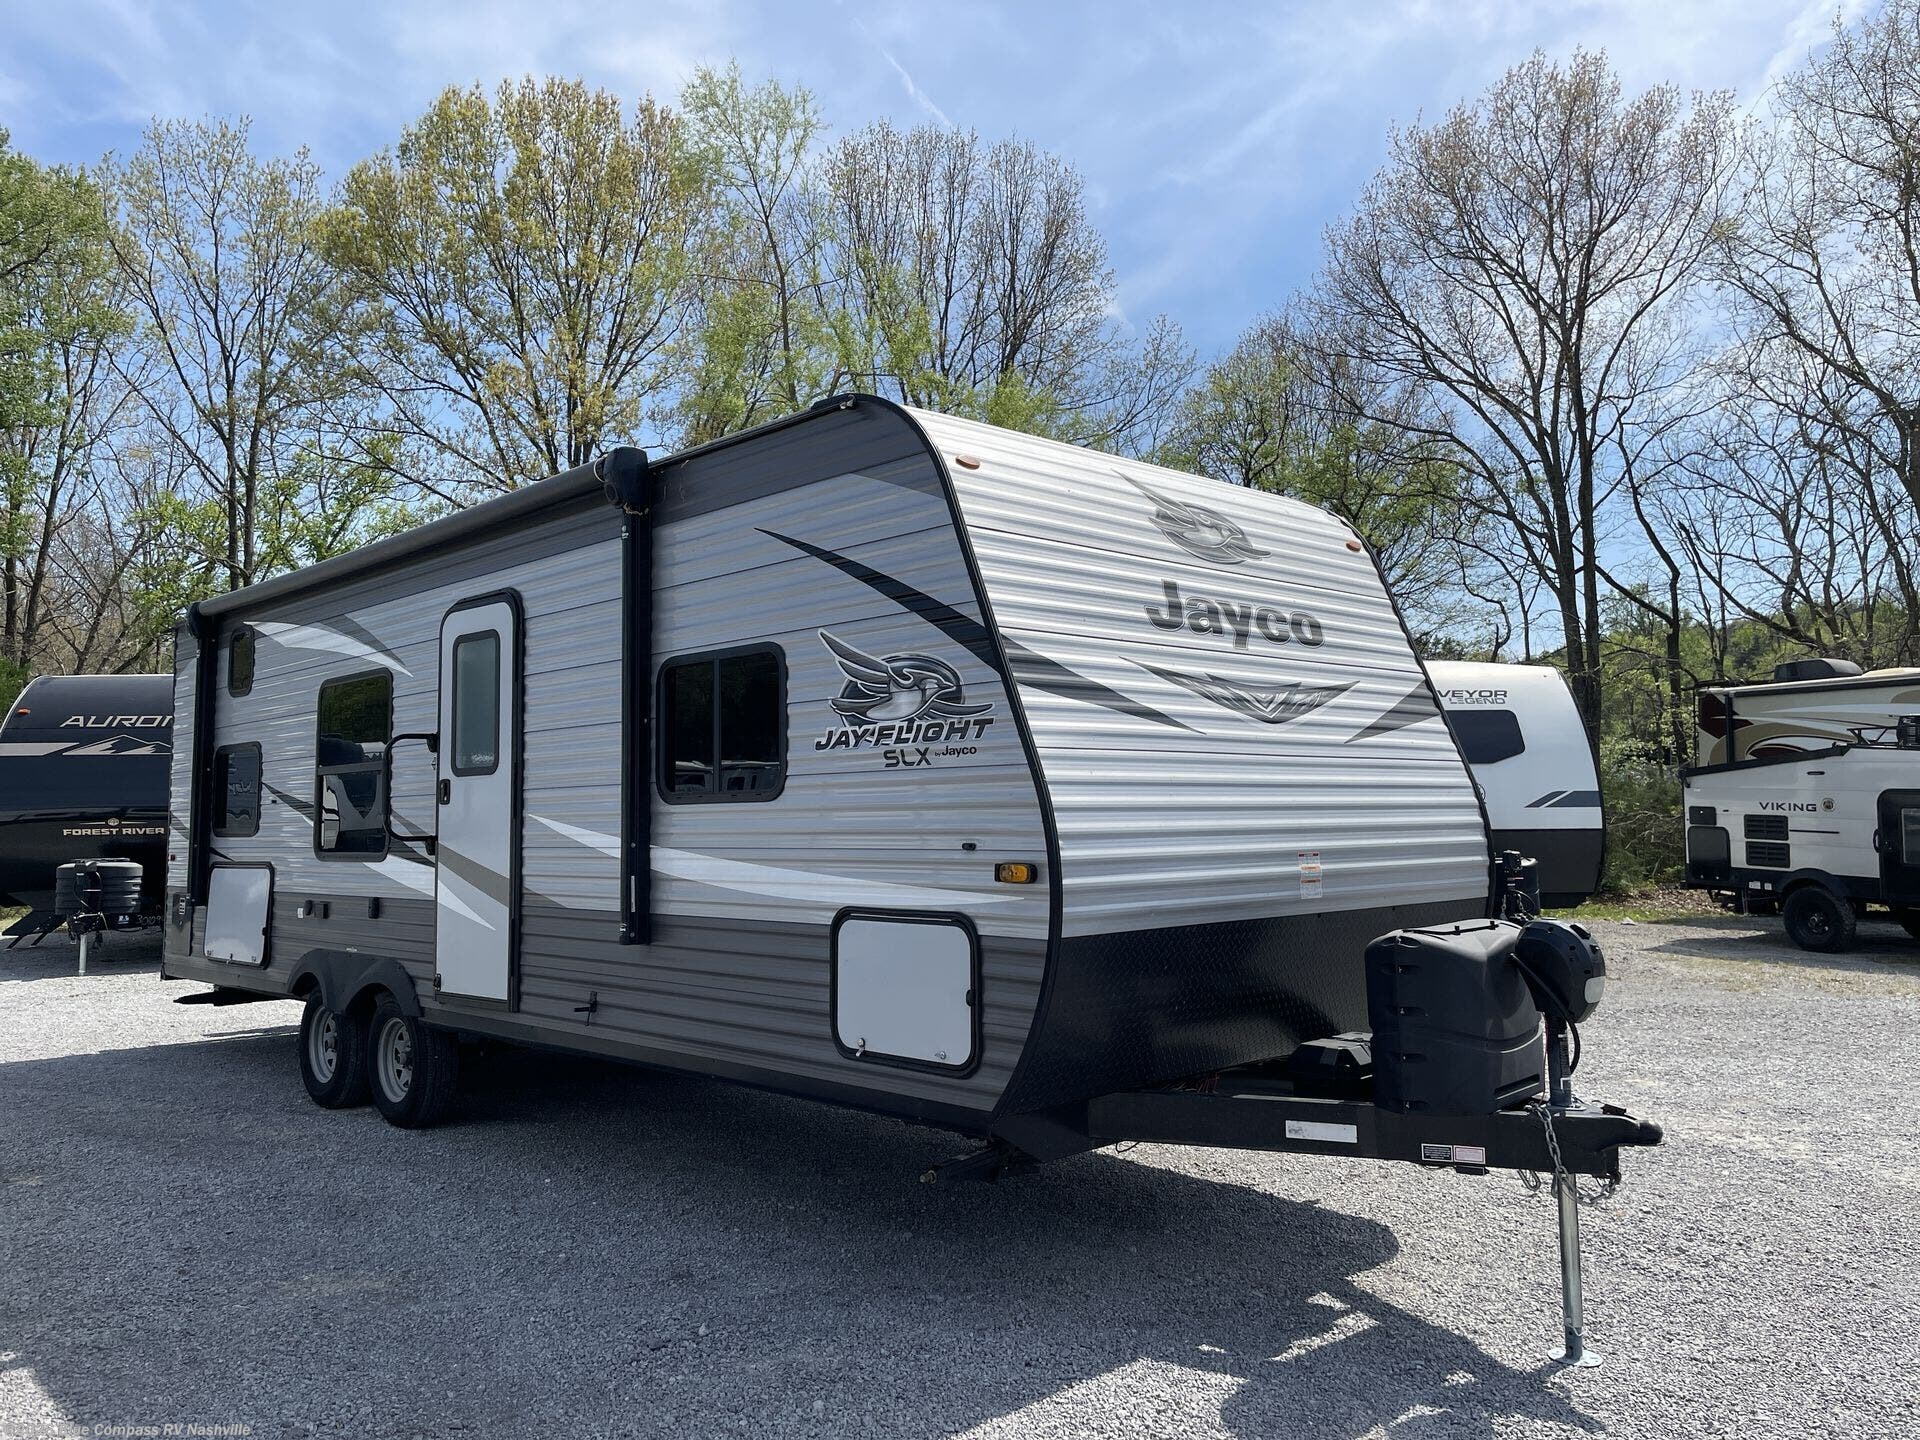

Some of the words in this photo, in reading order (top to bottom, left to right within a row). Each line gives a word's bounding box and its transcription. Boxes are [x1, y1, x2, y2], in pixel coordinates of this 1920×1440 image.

[1144, 578, 1326, 649] Jayco
[1449, 697, 1506, 705] LEGEND
[883, 746, 932, 768] SLX
[941, 745, 978, 758] Jayco
[1759, 801, 1817, 812] VIKING
[63, 828, 119, 837] FOREST
[121, 827, 165, 836] RIVER
